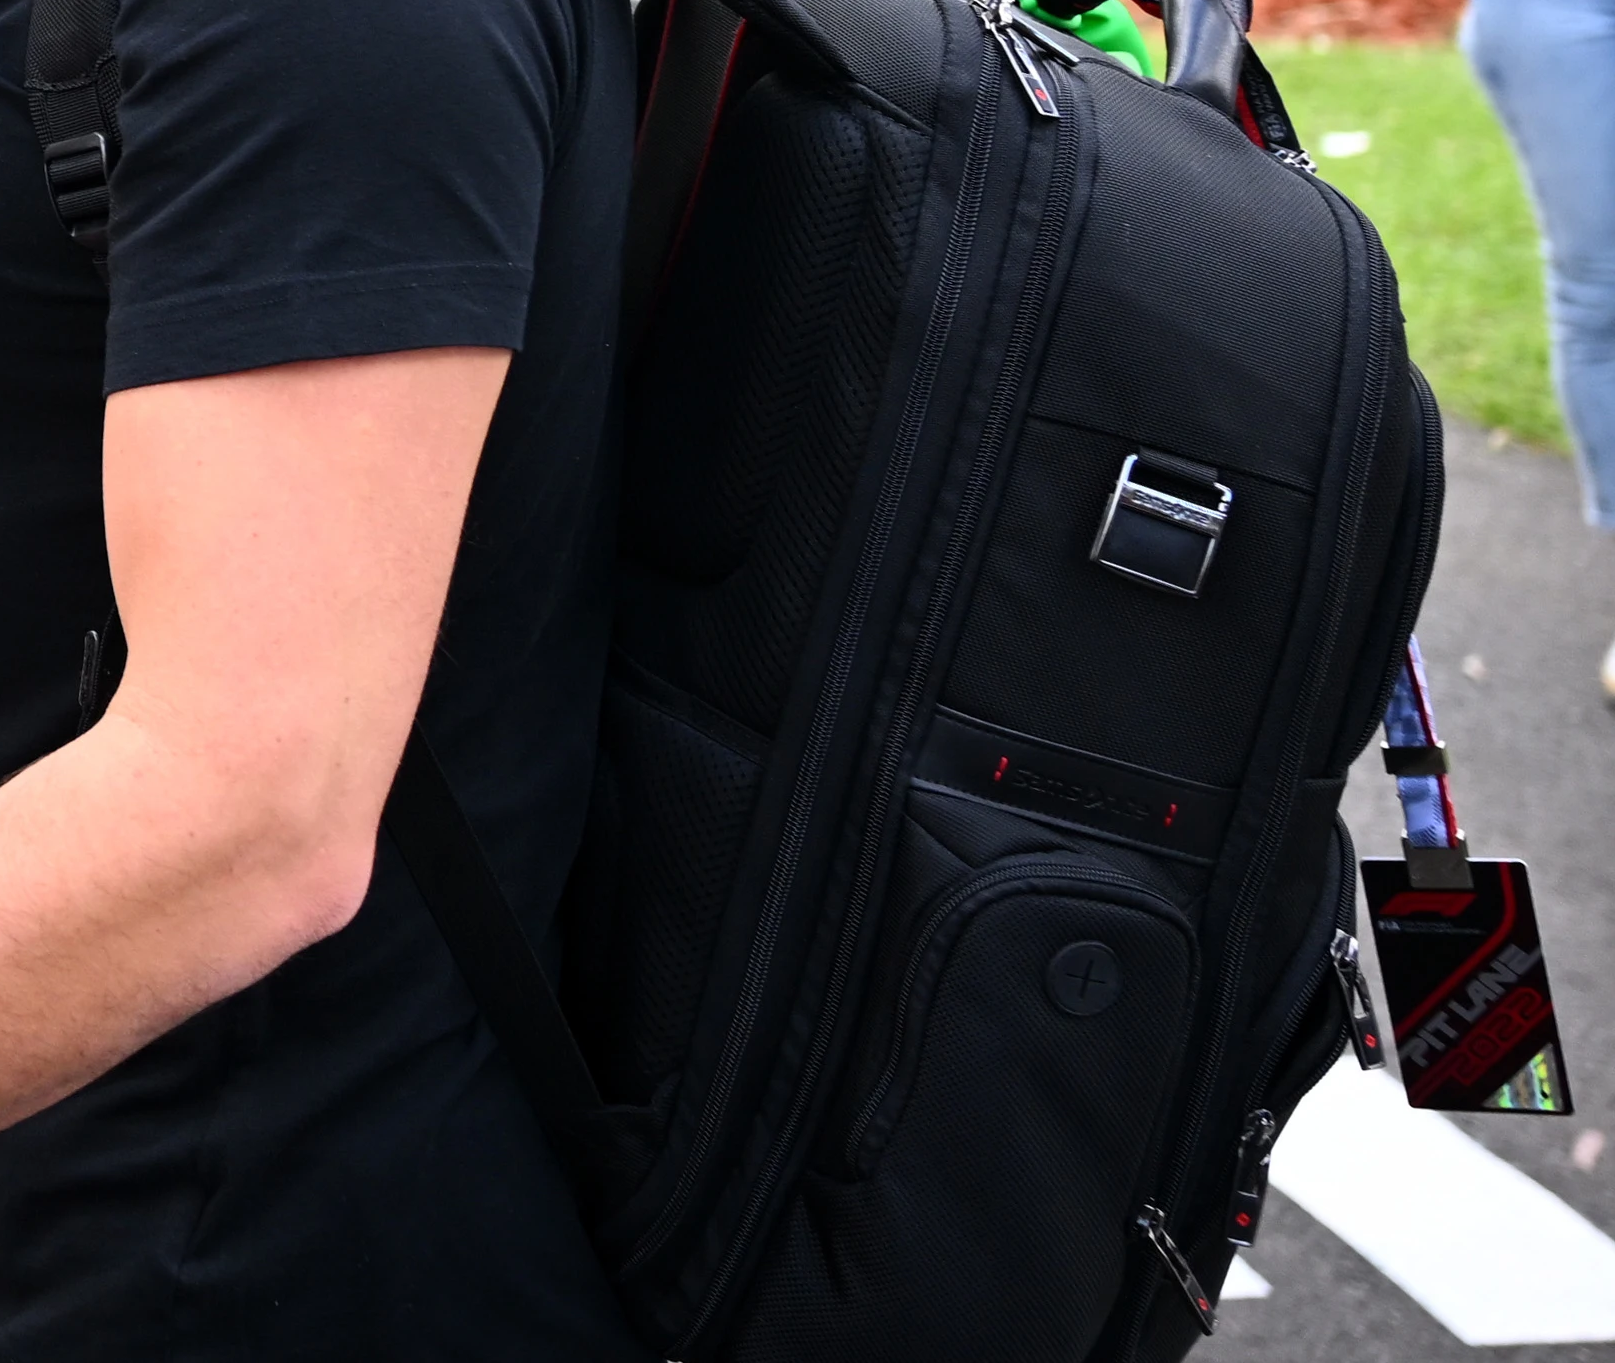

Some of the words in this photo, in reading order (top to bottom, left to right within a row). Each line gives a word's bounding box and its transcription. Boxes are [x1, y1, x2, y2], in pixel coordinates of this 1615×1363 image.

[1403, 1008, 1461, 1069] PIT
[1446, 942, 1536, 1026] LANE
[1448, 986, 1547, 1087] 2022
